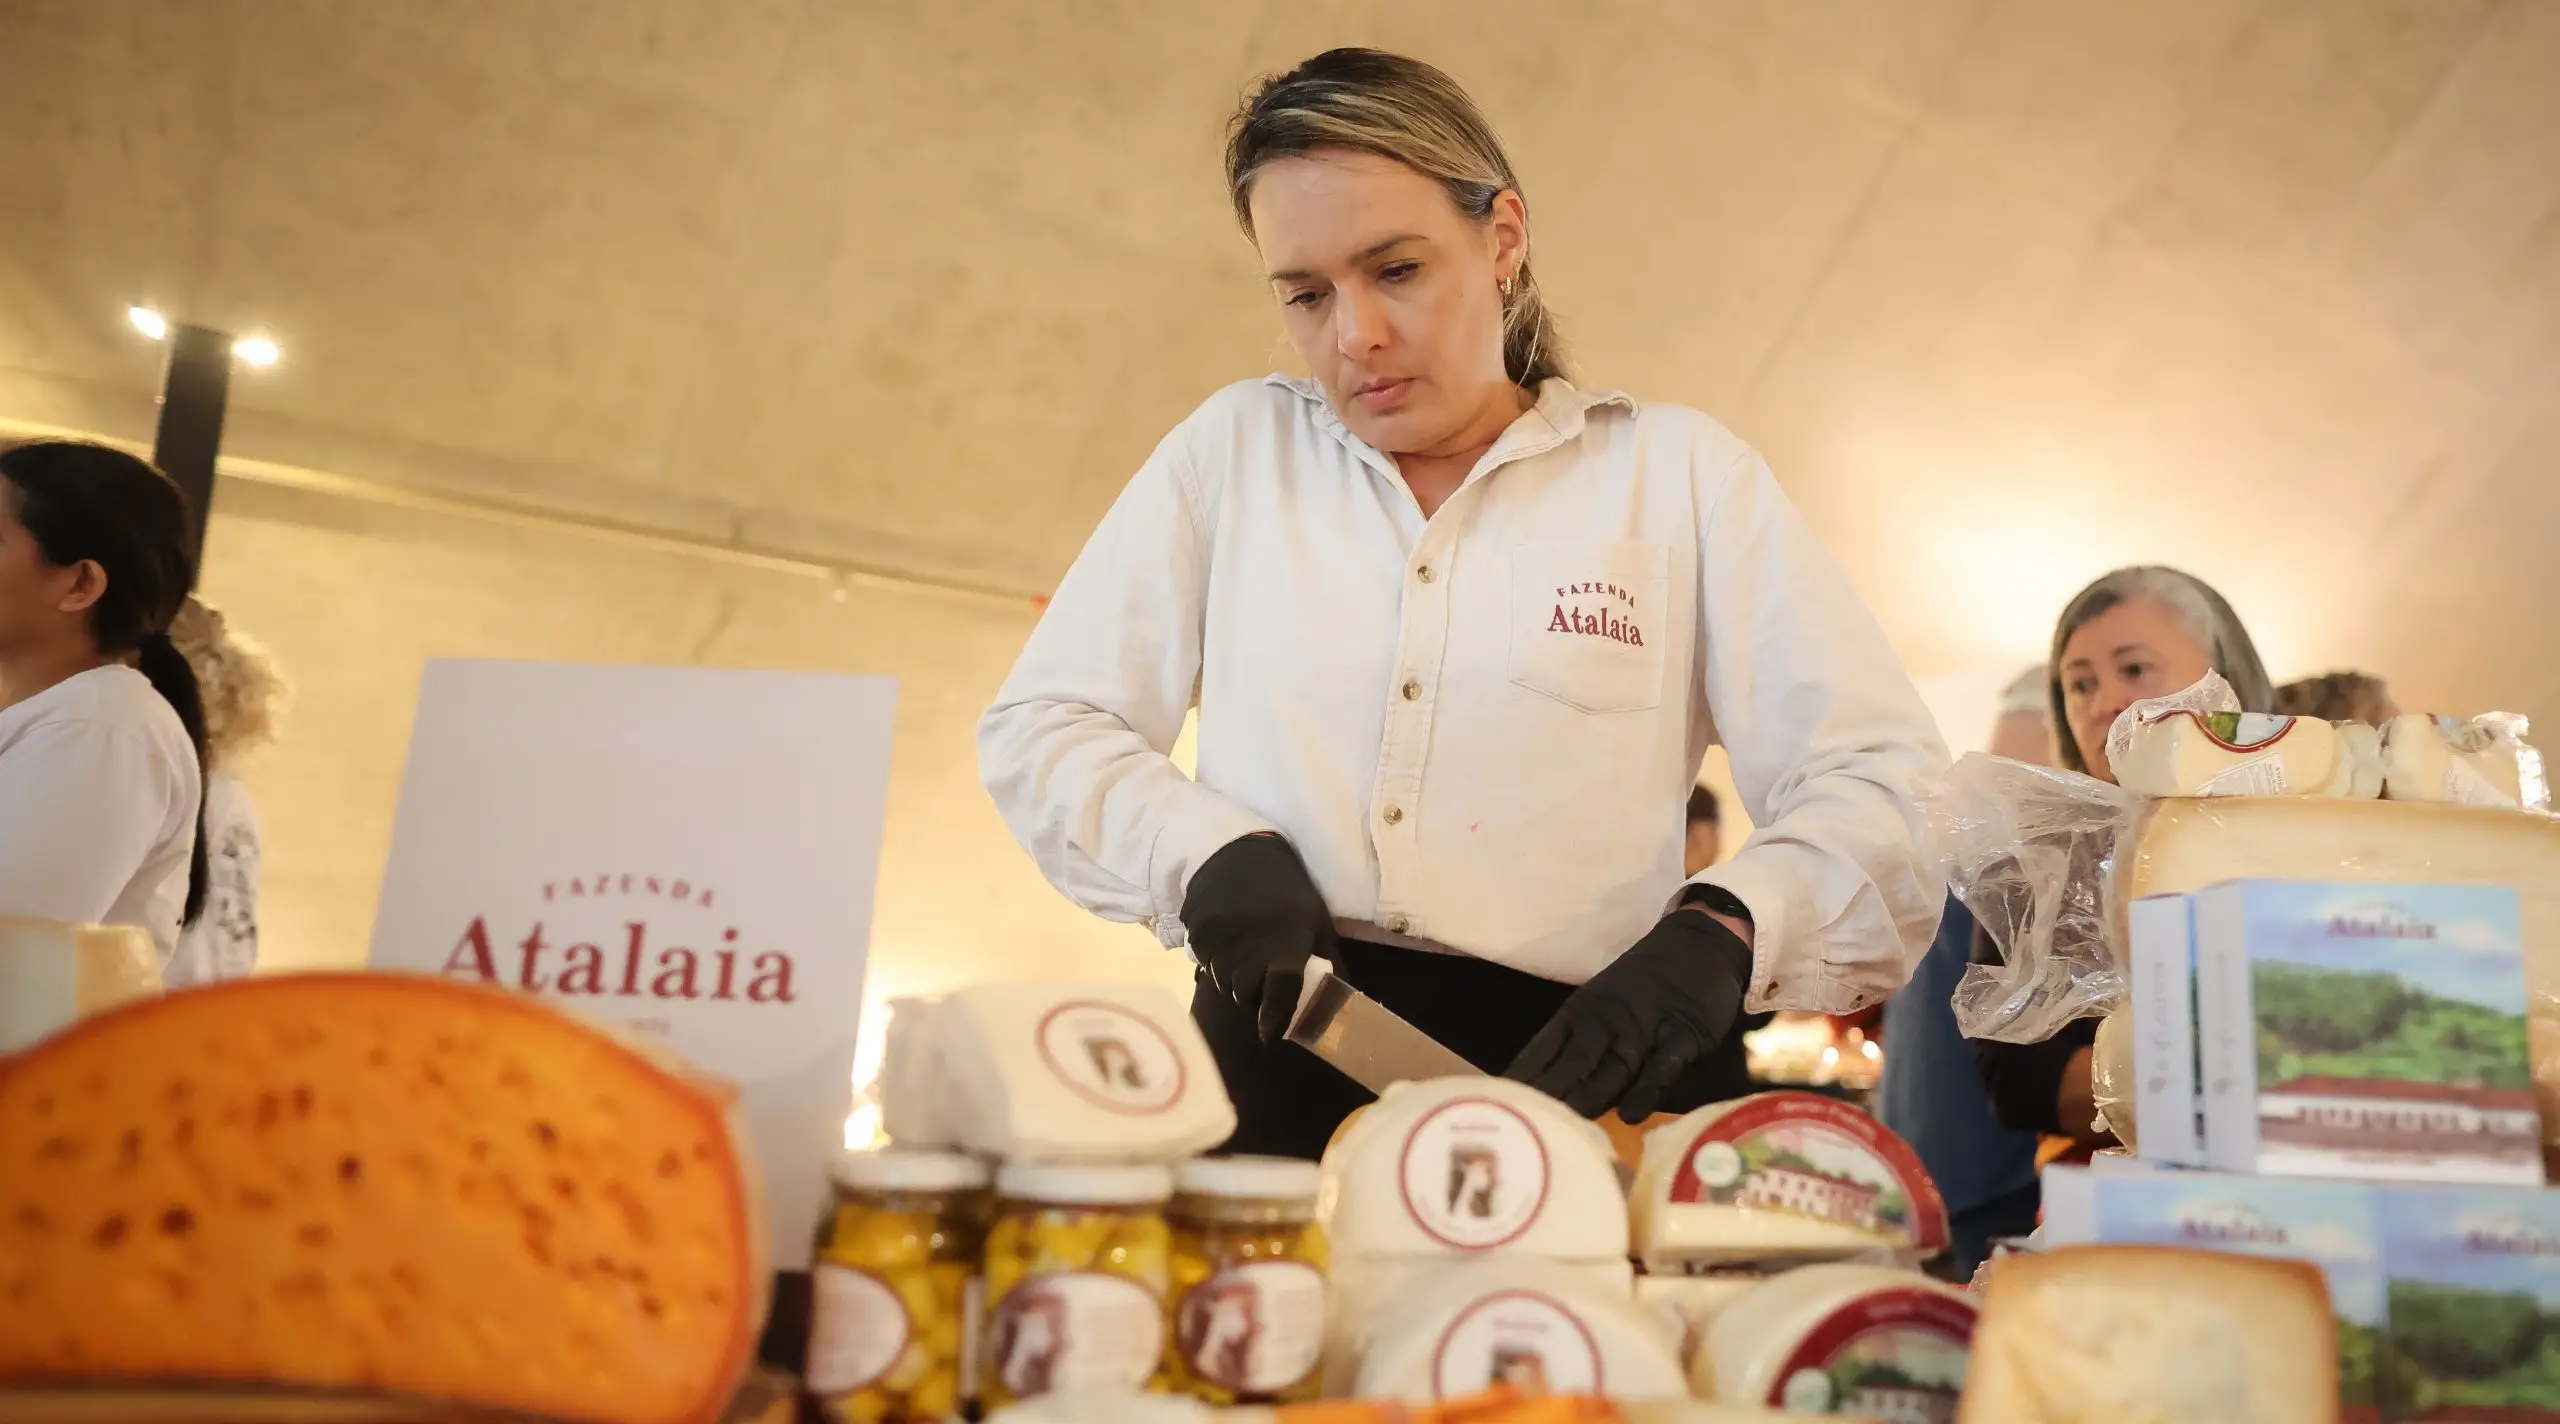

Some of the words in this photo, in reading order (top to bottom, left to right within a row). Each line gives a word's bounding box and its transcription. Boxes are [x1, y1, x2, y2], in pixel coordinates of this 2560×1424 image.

[1556, 582, 1635, 608] FAZENDA
[1548, 604, 1644, 647] Atalaia
[541, 873, 714, 909] FAZENDA
[441, 914, 798, 1004] Atalaia
